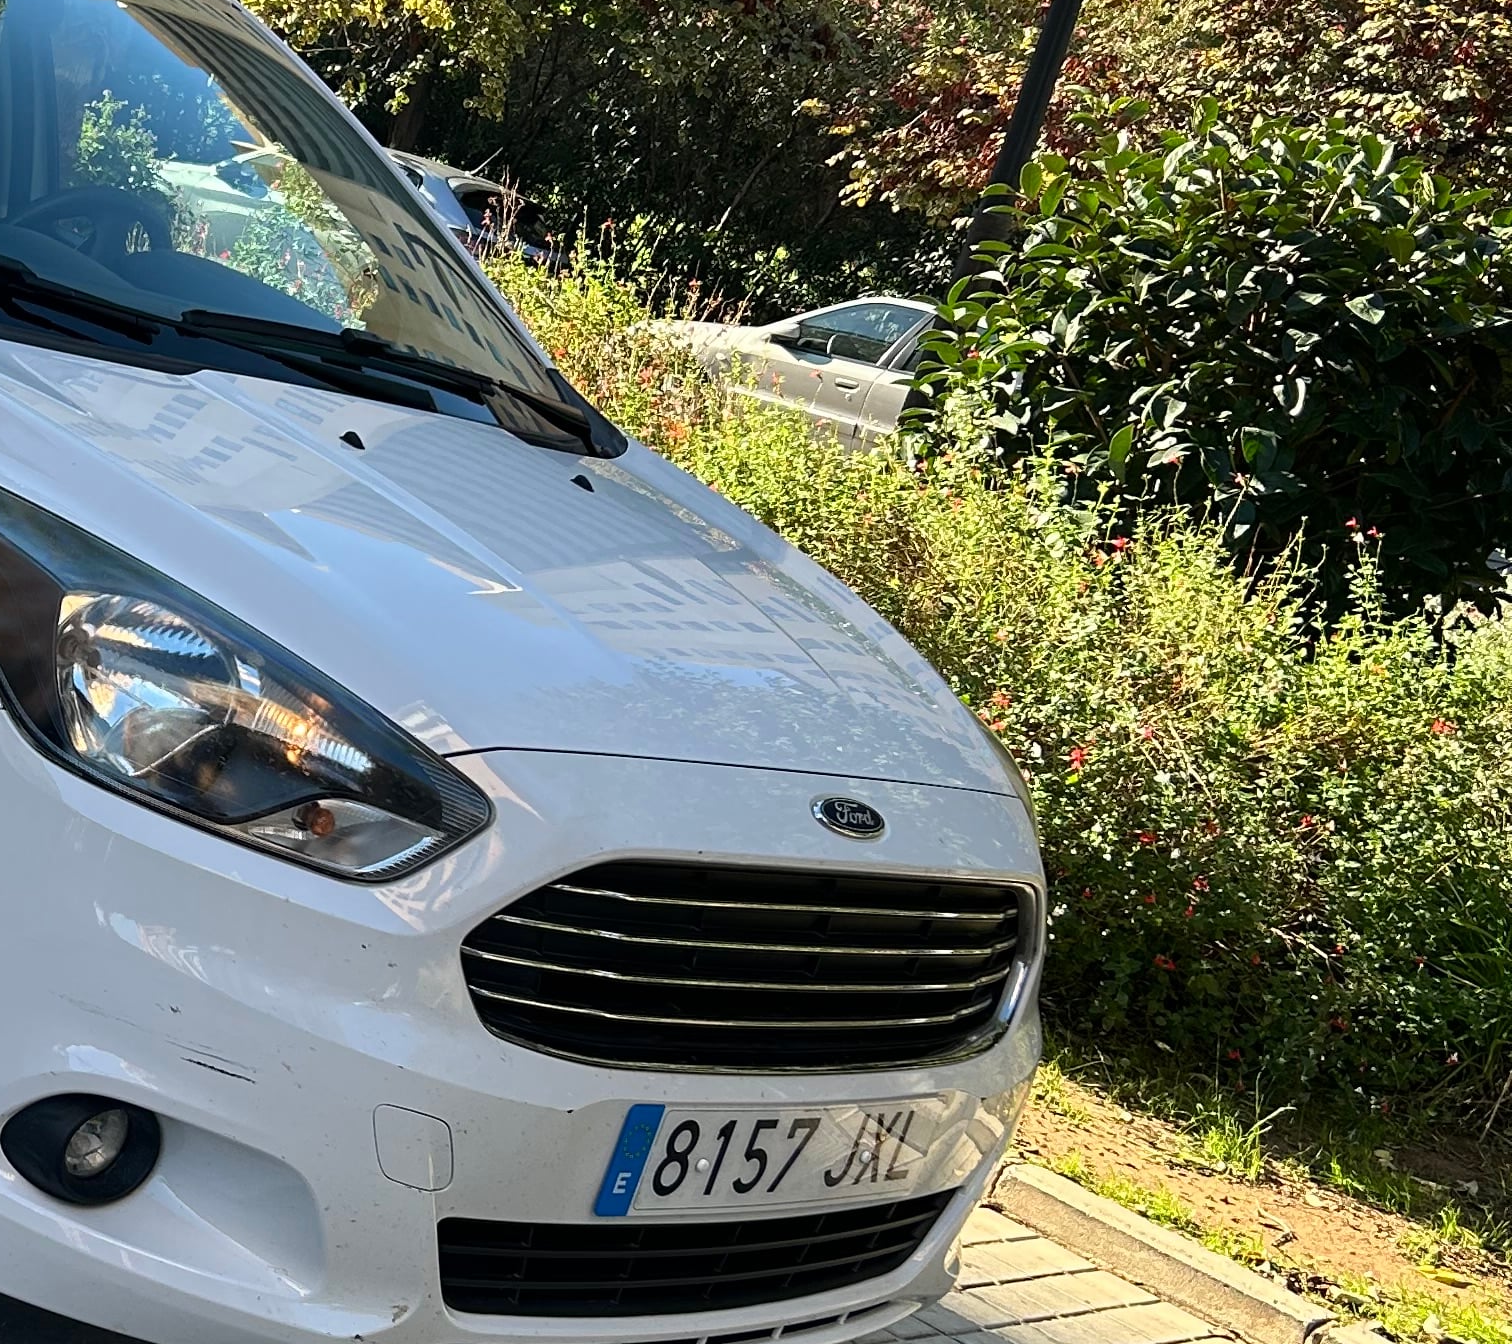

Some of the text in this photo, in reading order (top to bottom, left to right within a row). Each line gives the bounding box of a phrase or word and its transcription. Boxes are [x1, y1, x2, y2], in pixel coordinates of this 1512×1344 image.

[834, 801, 874, 825] Ford
[652, 1110, 915, 1197] 8157 JXL
[612, 1172, 631, 1194] E
